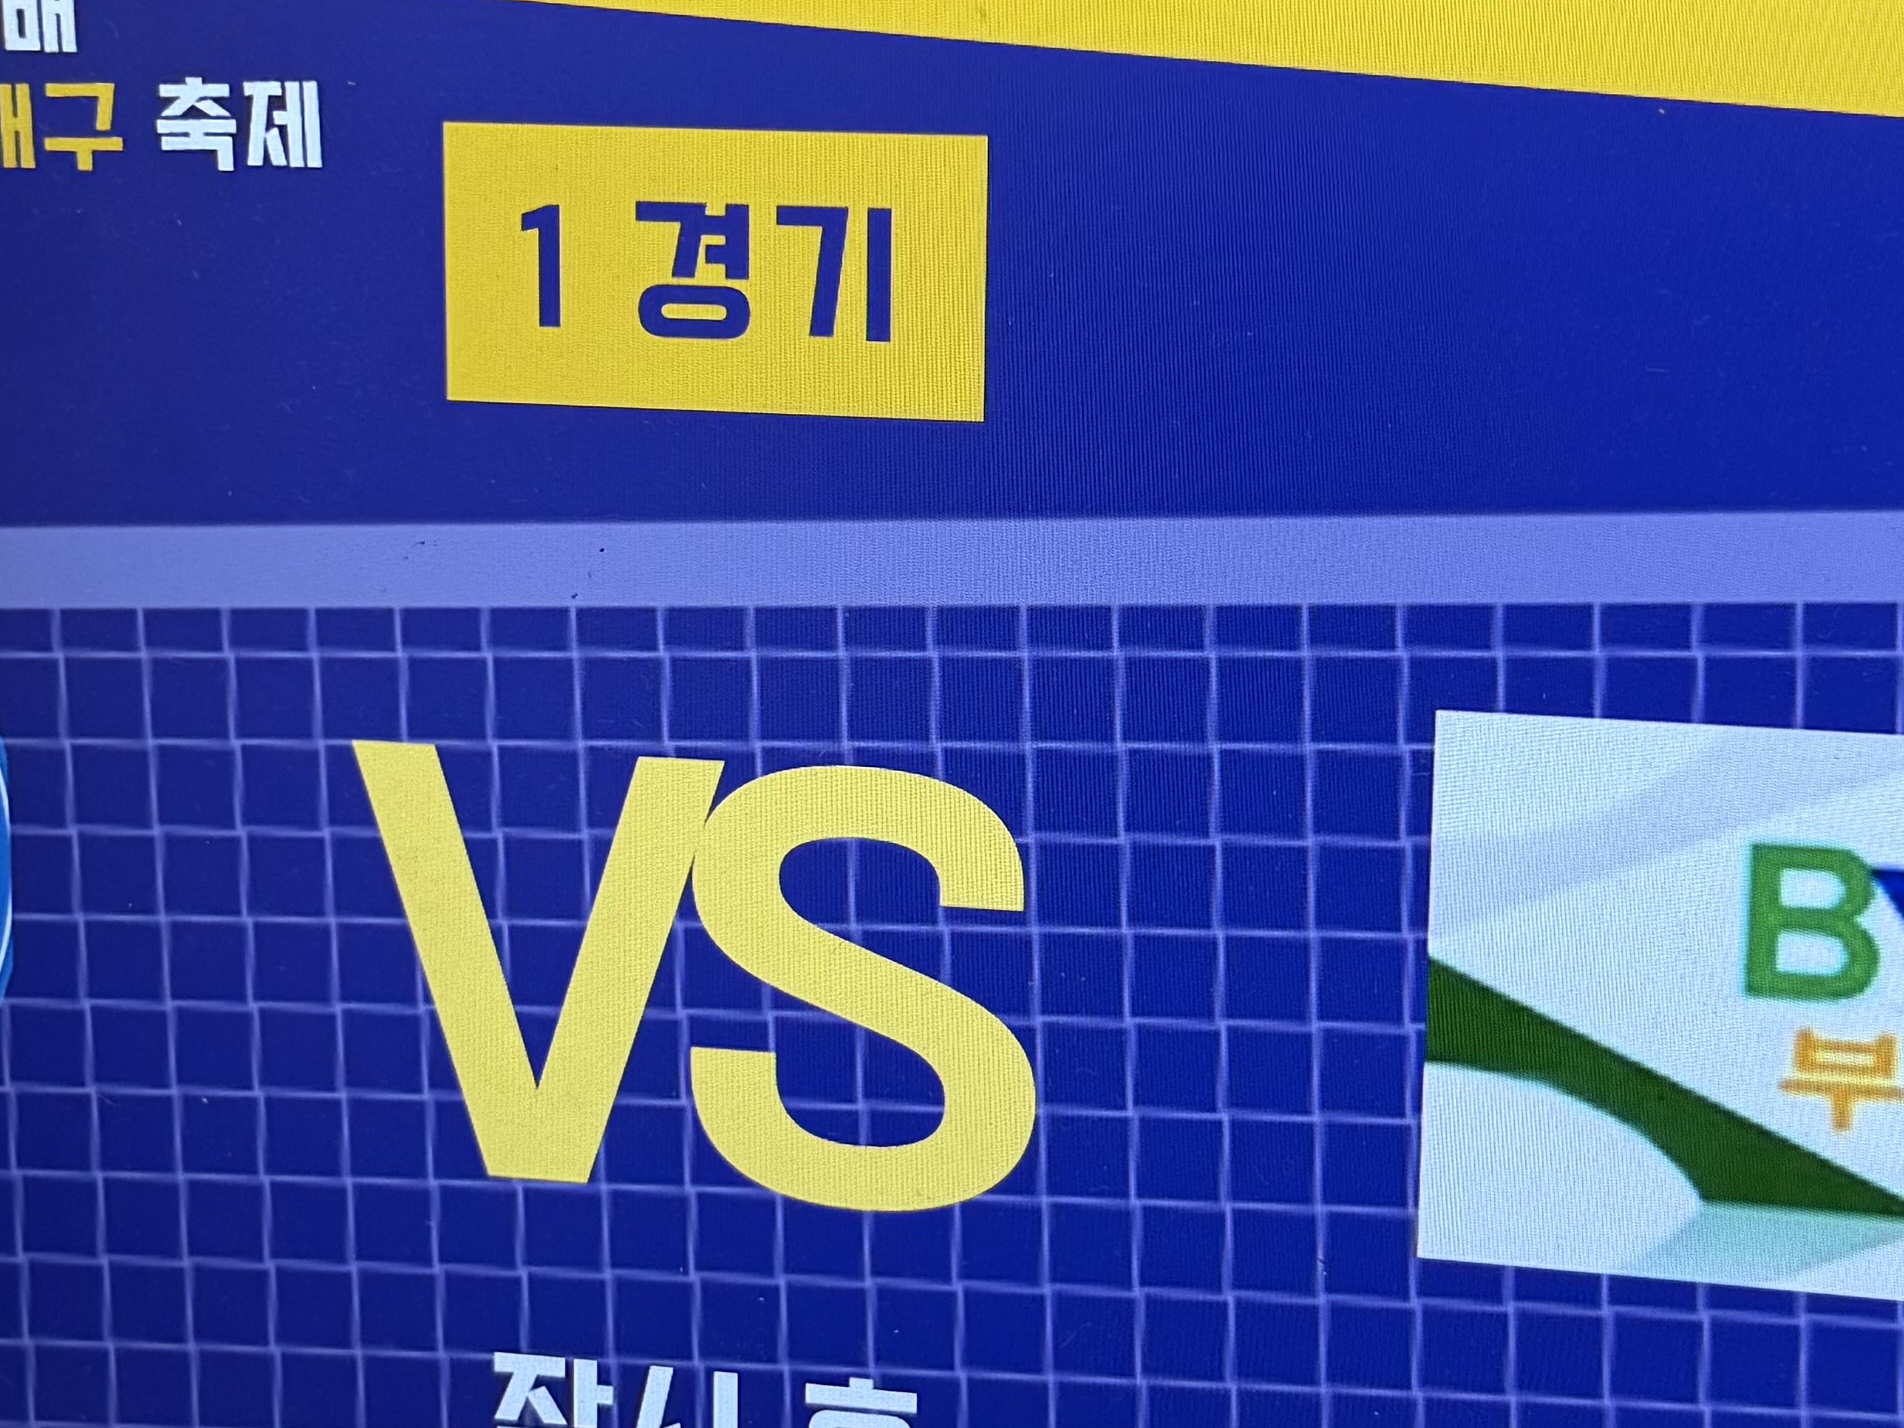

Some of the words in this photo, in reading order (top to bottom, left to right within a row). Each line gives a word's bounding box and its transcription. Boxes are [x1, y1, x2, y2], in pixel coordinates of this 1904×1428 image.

[156, 77, 322, 171] 축제
[521, 204, 560, 327] 1
[635, 201, 892, 342] 경기
[353, 740, 1036, 1212] VS
